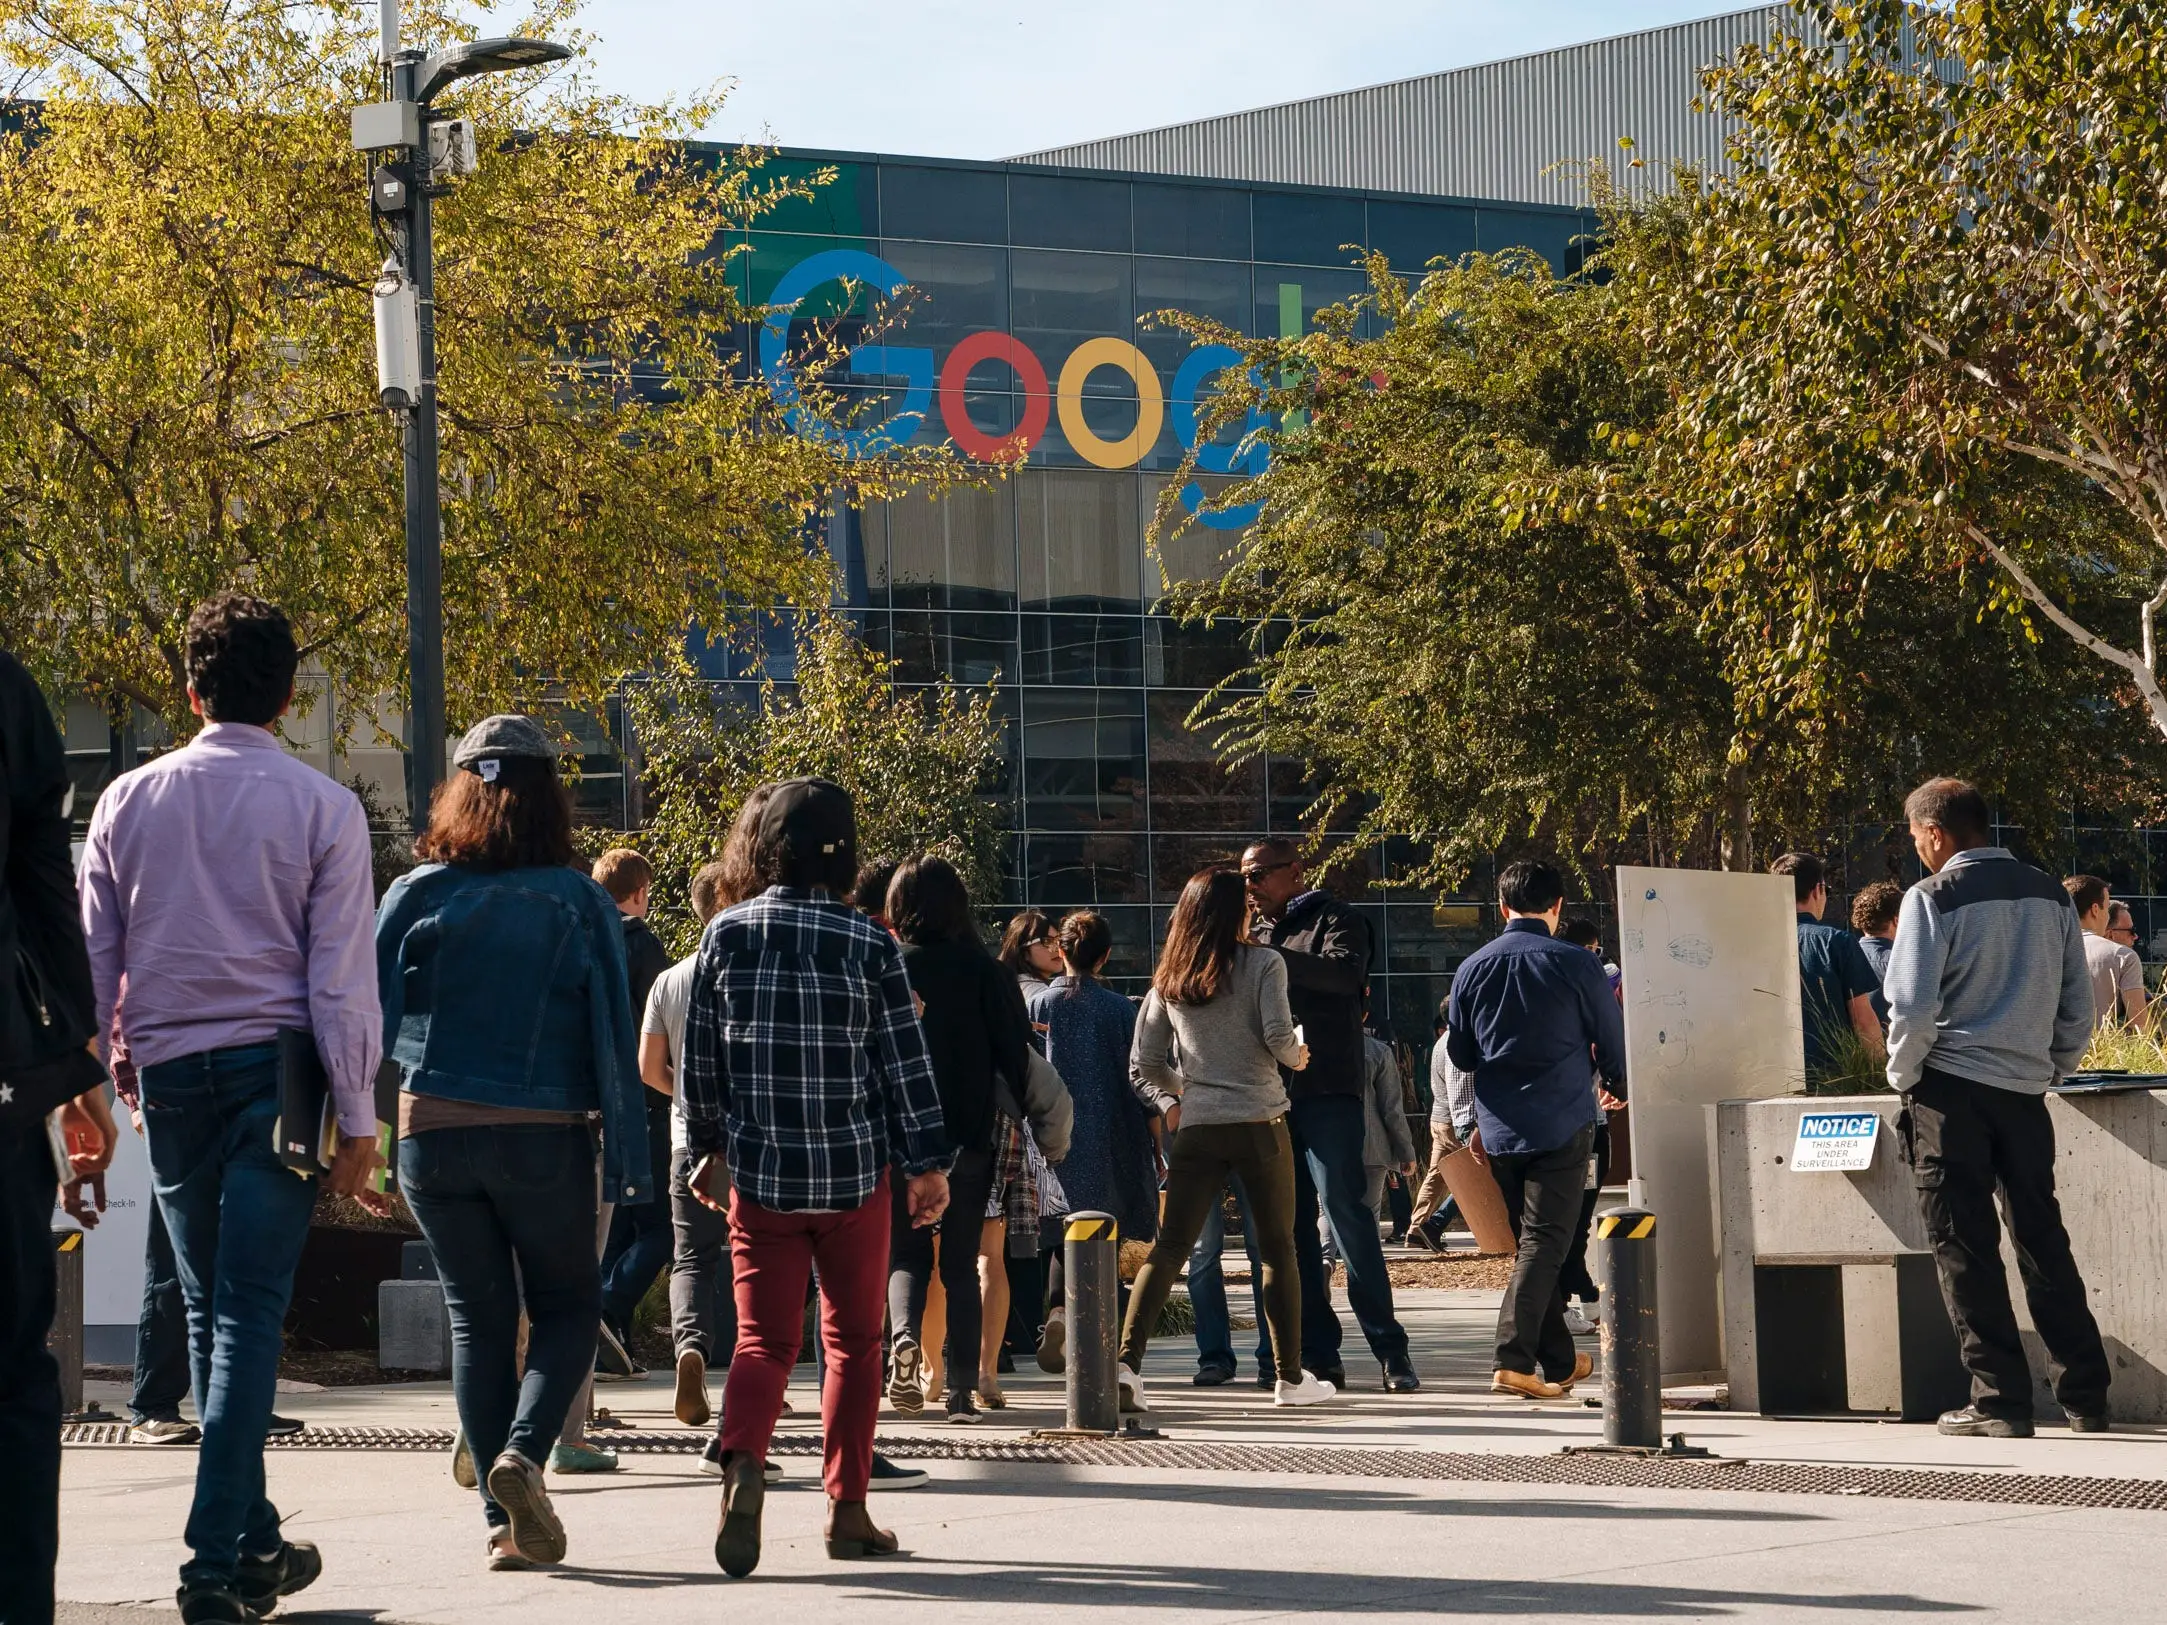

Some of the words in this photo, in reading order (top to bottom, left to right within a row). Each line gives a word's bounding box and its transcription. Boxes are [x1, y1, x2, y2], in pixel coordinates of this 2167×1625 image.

[759, 249, 1388, 530] Googl
[1803, 1117, 1874, 1136] NOTICE
[1812, 1141, 1831, 1149] THIS
[1834, 1140, 1858, 1148] AREA
[1817, 1150, 1848, 1158] UNDER
[1797, 1159, 1866, 1168] SURVEILLANCE
